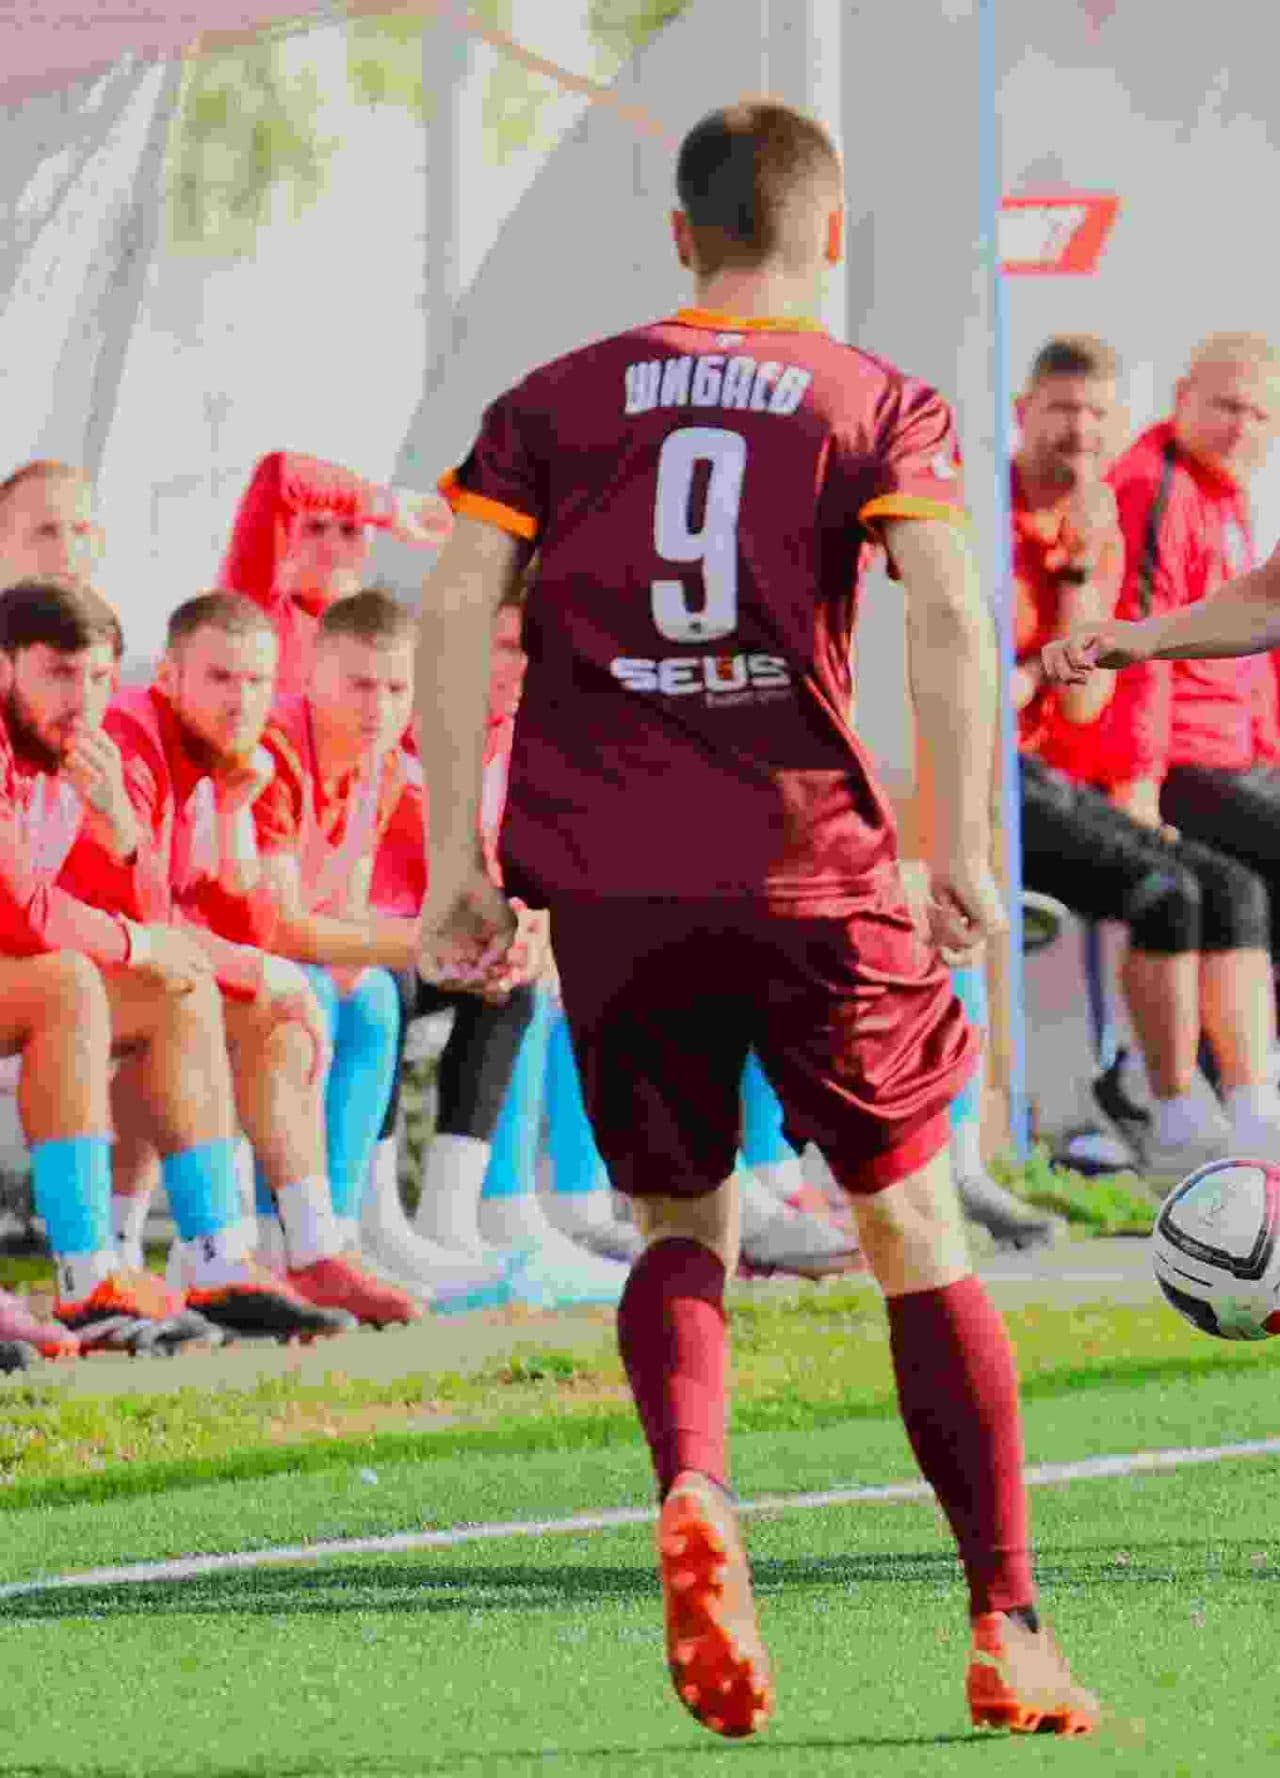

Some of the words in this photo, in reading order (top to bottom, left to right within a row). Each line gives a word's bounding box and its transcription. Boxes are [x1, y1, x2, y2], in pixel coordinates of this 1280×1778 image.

[625, 355, 813, 415] ШИБАЕВ
[651, 426, 747, 641] 9
[610, 654, 791, 695] SEUS
